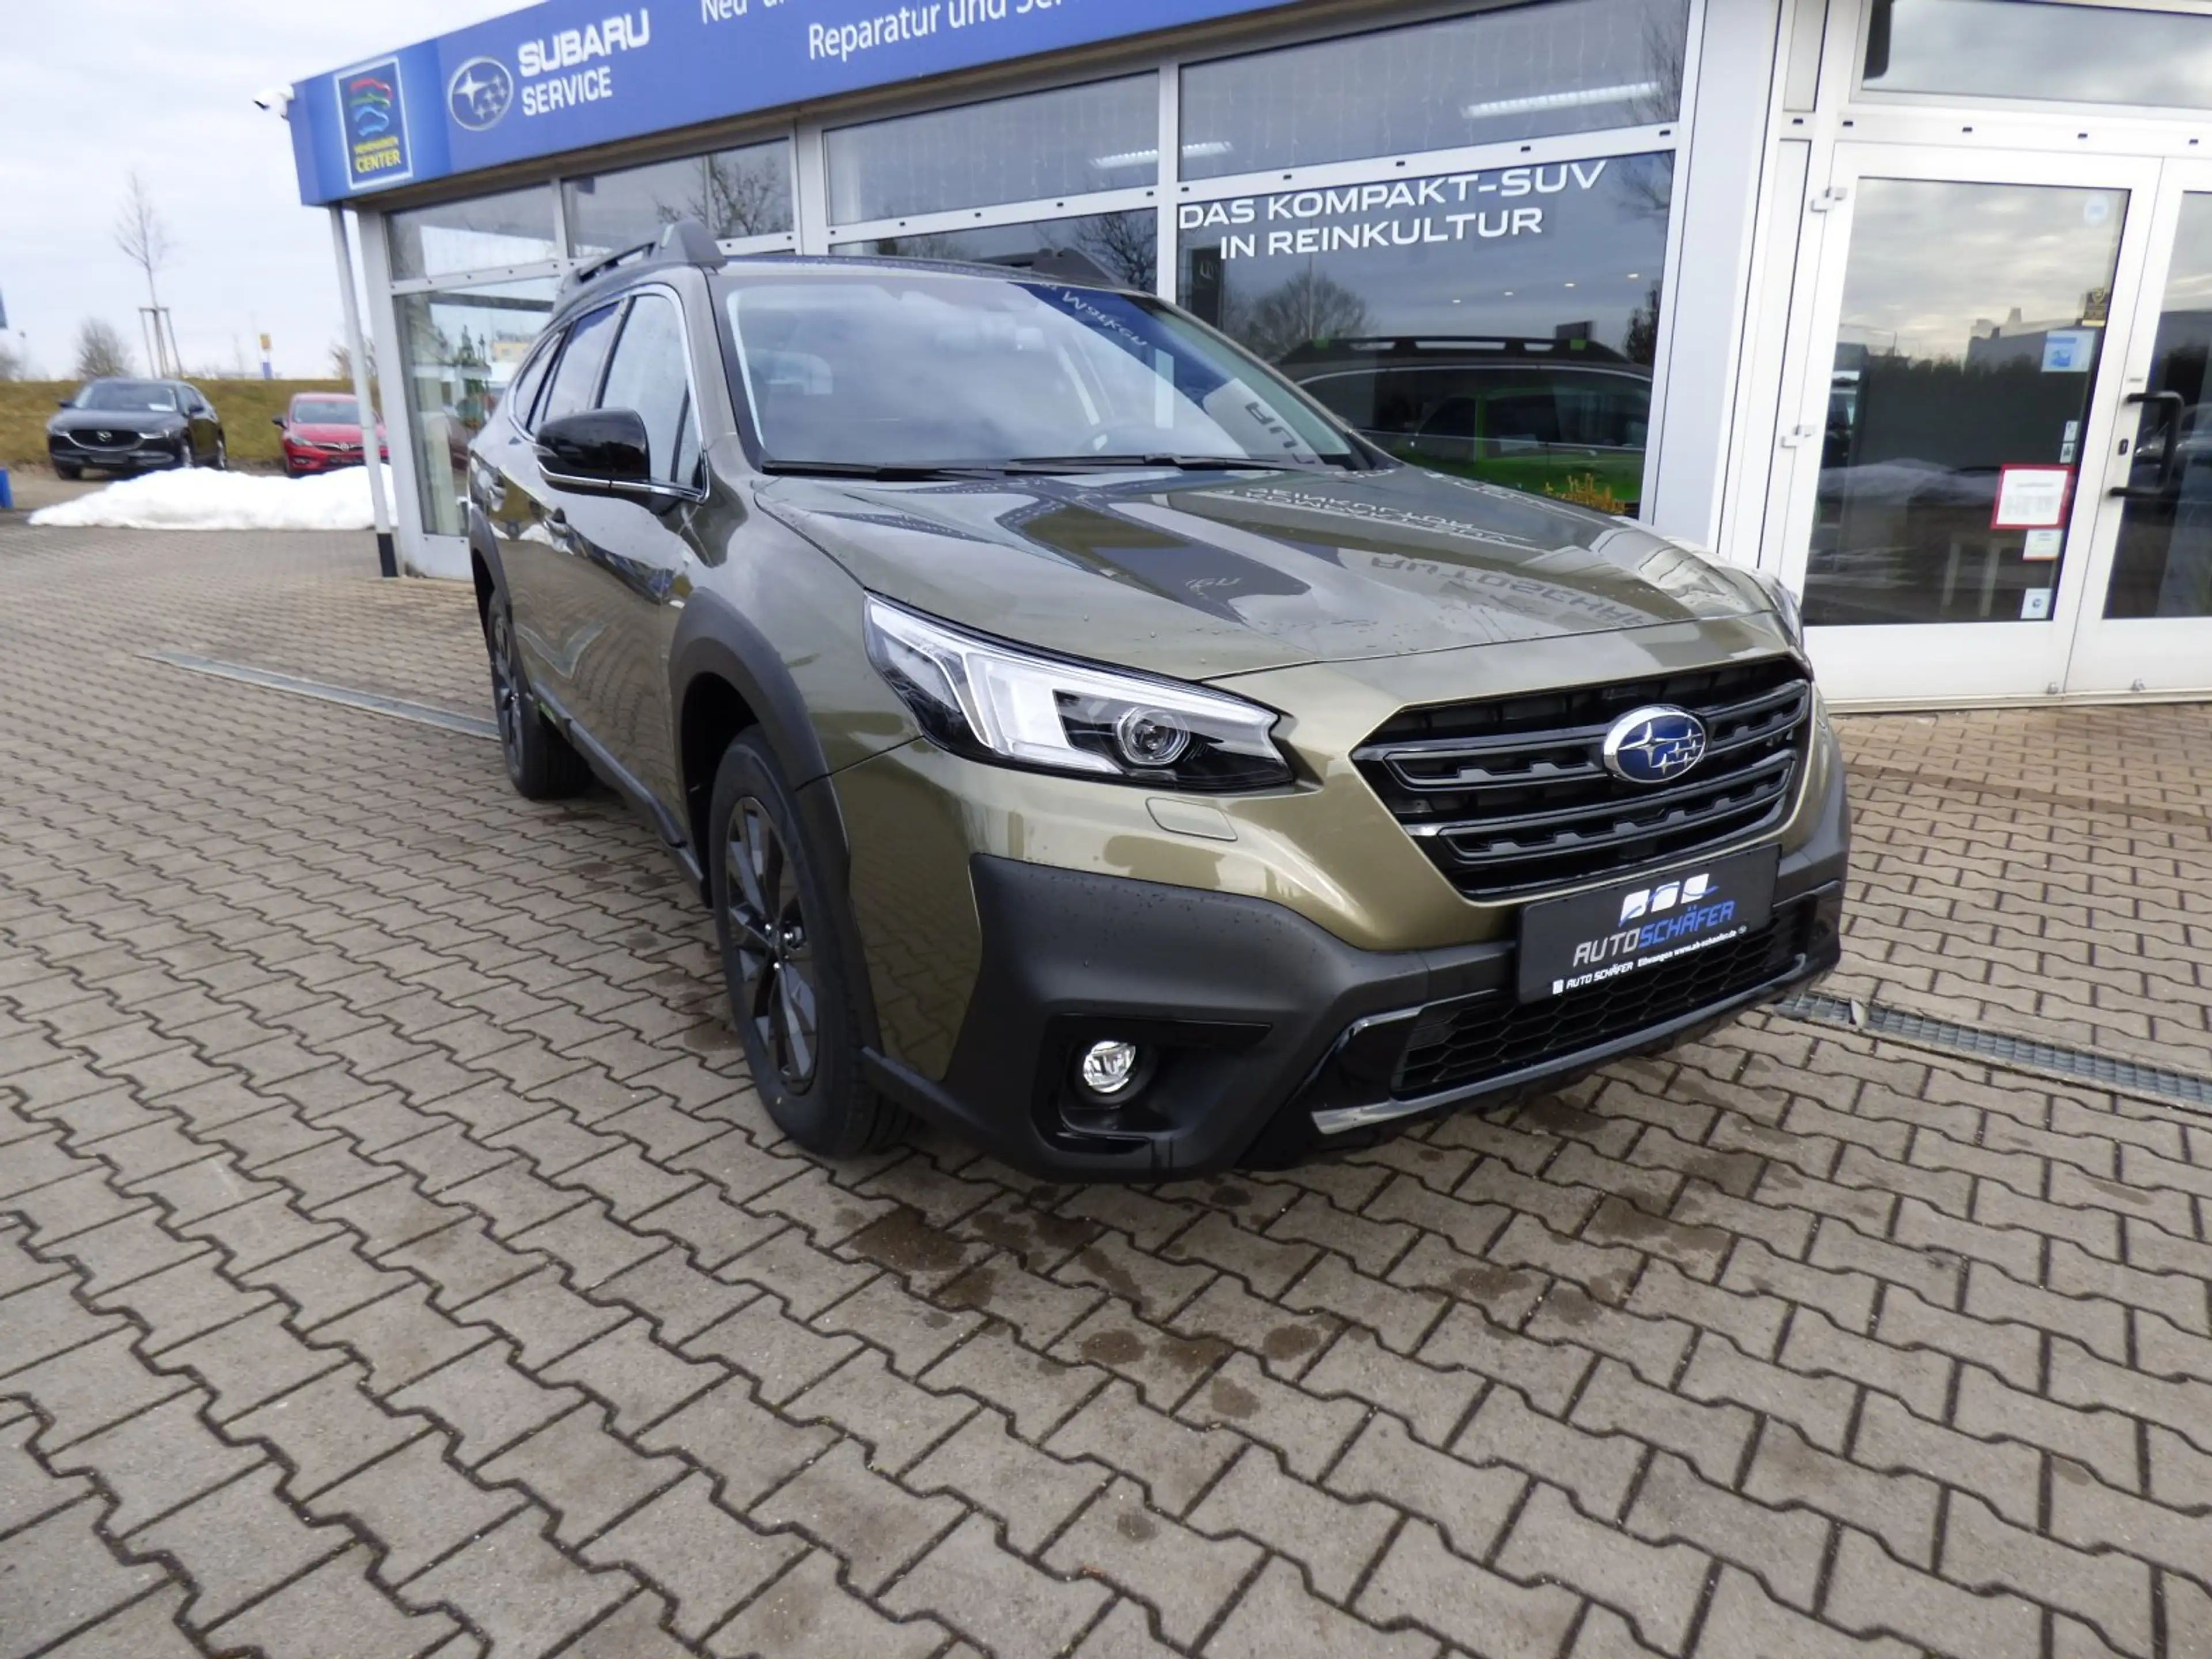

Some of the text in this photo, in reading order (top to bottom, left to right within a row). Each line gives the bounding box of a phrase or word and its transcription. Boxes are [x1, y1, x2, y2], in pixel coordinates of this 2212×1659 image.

[518, 7, 650, 78] SUBARU
[809, 3, 941, 62] Reparatur
[521, 65, 613, 116] SERVICE
[355, 149, 402, 173] CENTER
[1179, 160, 1607, 229] DAS KOMPAKT-SUV
[1219, 207, 1543, 260] IN REINKULTUR
[1566, 973, 1593, 990] AUTO
[1593, 961, 1634, 982] SCHÄFER
